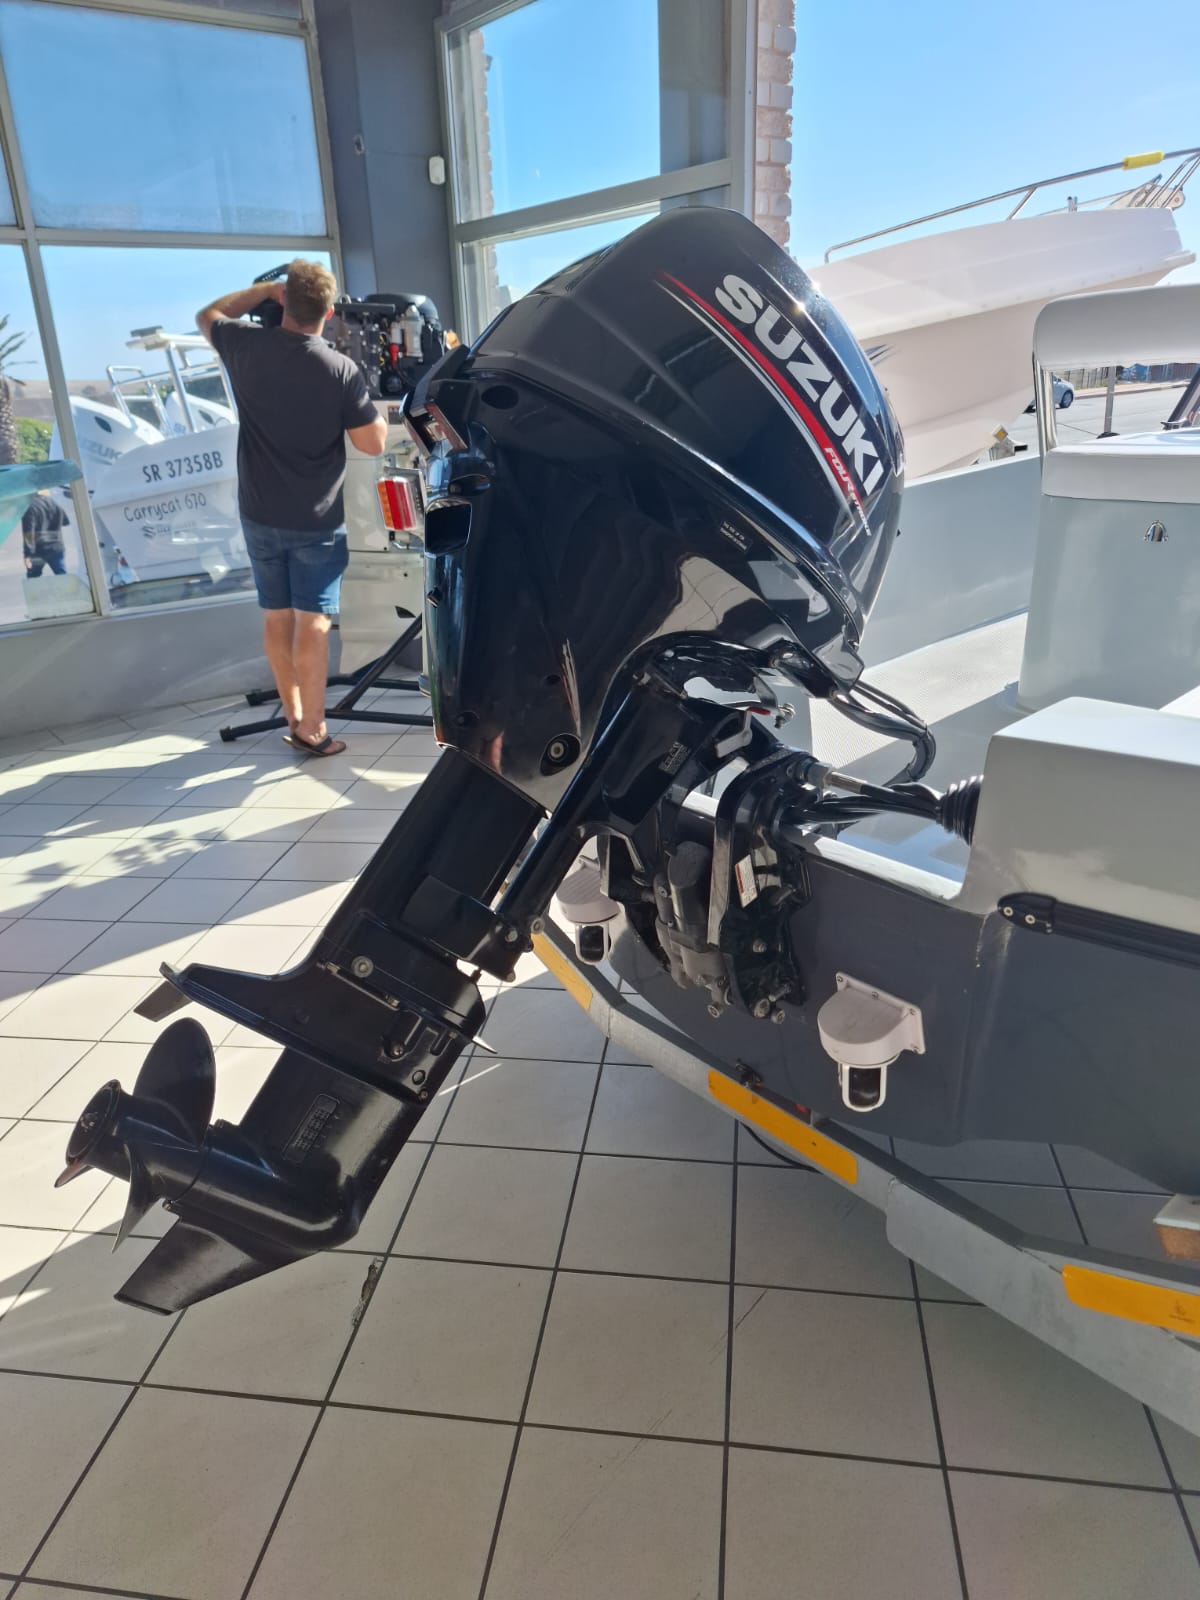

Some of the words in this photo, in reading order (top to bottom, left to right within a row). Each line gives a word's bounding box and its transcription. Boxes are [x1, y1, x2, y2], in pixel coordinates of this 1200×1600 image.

[714, 273, 884, 497] SUZUKI
[142, 464, 163, 484] SR
[165, 450, 224, 480] 37358B
[124, 496, 183, 523] Carrycat
[183, 491, 208, 512] 670
